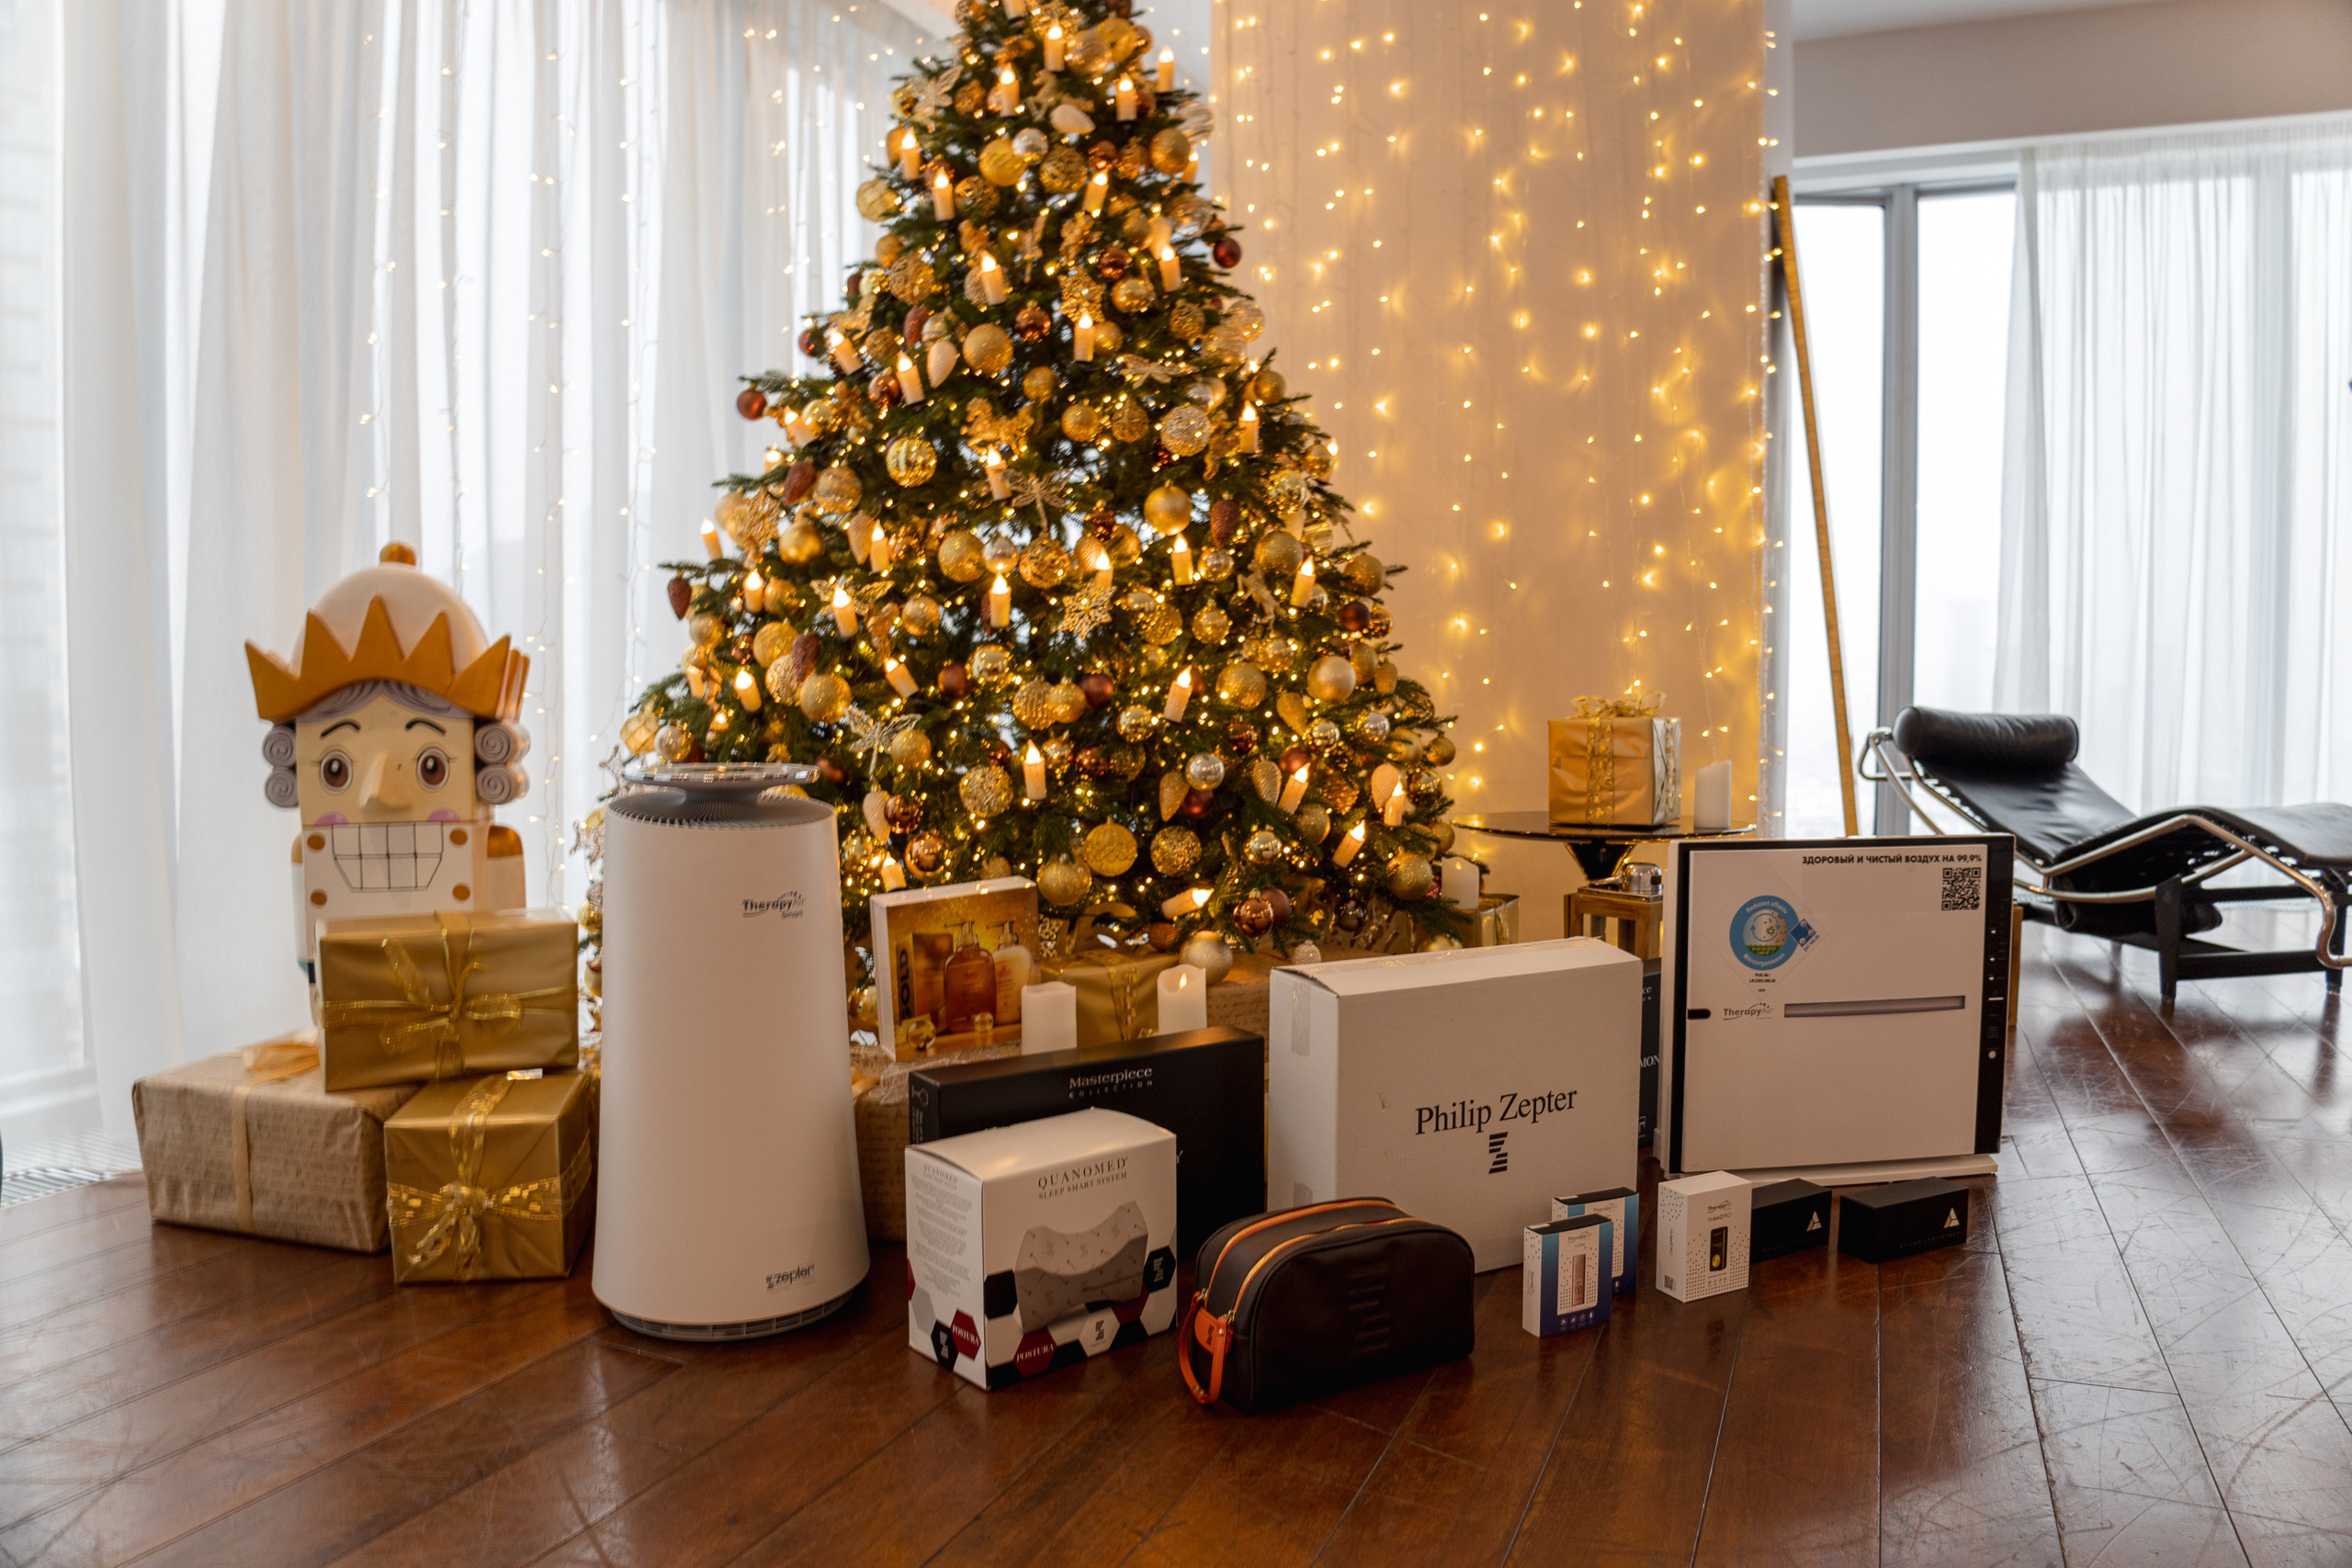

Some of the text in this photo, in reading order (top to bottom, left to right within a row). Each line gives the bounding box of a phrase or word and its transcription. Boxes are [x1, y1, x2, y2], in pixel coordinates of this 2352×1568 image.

[1802, 854, 1854, 864] ЗДОРОВЫЙ
[1866, 854, 1902, 863] ЧИСТЫЙ
[1905, 855, 1940, 864] ВОЗДУХ
[1957, 855, 1982, 864] 99,9%
[1069, 1067, 1153, 1090] Masterpiece
[1069, 1080, 1153, 1100] COLLECTION
[1415, 1089, 1577, 1135] Philip Zepter
[1038, 1156, 1126, 1190] QUANOMED
[1038, 1171, 1128, 1201] SLEEP SMART SYSTEM
[952, 1324, 980, 1348] POSTURA
[1016, 1343, 1055, 1363] POSTURA
